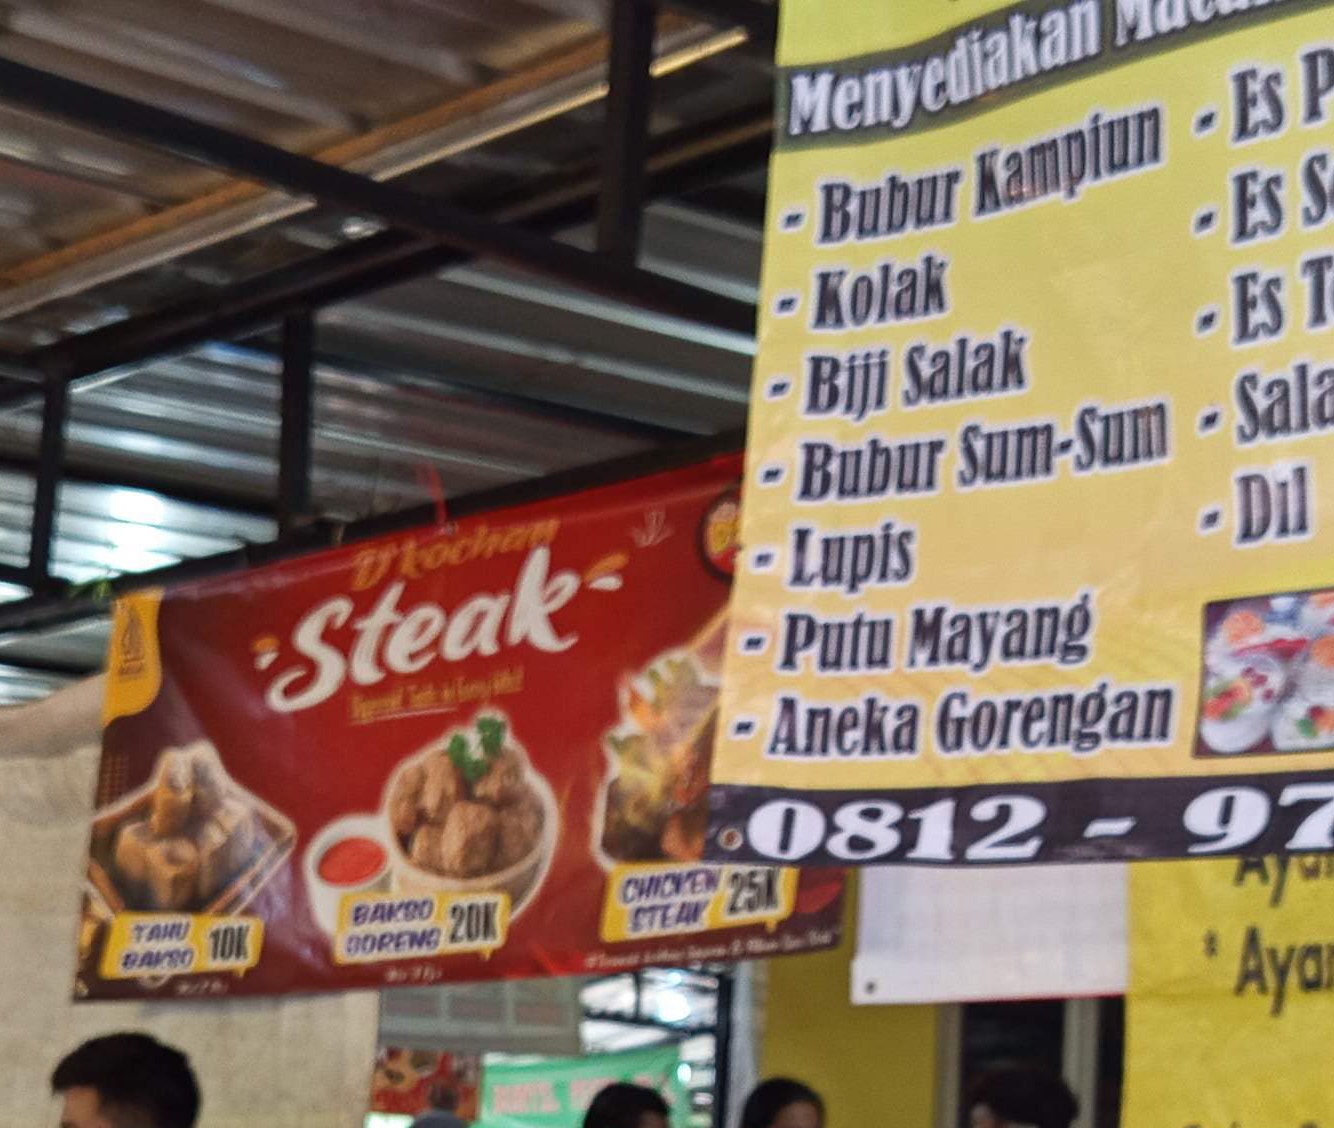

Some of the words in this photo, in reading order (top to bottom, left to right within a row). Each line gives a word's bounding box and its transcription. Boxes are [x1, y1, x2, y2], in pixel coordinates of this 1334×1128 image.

[788, 0, 1103, 135] Menyediakan
[1115, 0, 1273, 46] Mac
[1232, 67, 1283, 143] Es
[817, 169, 961, 244] Bubur
[973, 106, 1162, 219] Kampiun
[1232, 169, 1283, 244] Es
[812, 255, 948, 331] Kolak
[1234, 272, 1284, 344] Es
[804, 353, 887, 422] Biji
[903, 331, 1028, 405] Salak
[797, 441, 943, 500] Bubur
[959, 403, 1167, 489] Sum-Sum
[789, 522, 914, 592] Lupis
[267, 545, 580, 712] Steak
[778, 612, 893, 672] Putu
[908, 594, 1092, 669] Mayang
[770, 699, 918, 755] Aneka
[939, 684, 1172, 752] Gorengan
[748, 796, 1047, 862] 0812
[353, 900, 433, 927] BAKSO
[448, 901, 498, 943] 20K
[622, 869, 718, 902] CHICKEN
[134, 921, 191, 942] TAHU
[209, 925, 251, 961] 10K
